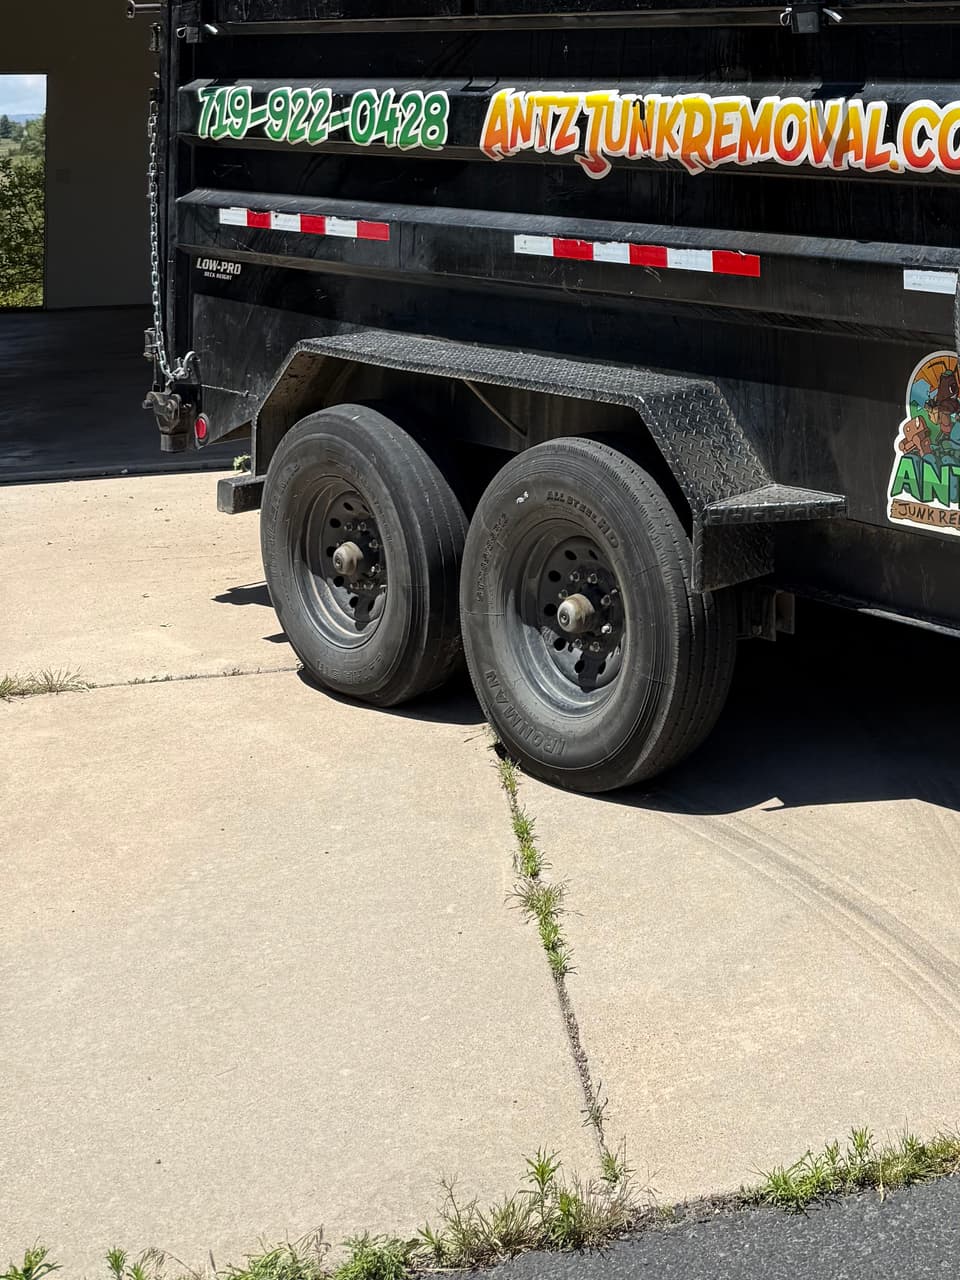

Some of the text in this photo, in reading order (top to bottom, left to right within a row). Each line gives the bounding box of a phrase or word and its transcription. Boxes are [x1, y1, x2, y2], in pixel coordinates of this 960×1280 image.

[197, 86, 451, 151] 719-922-0428
[546, 490, 565, 503] ALL
[898, 502, 936, 522] JUNK
[485, 669, 567, 755] IRONMAN
